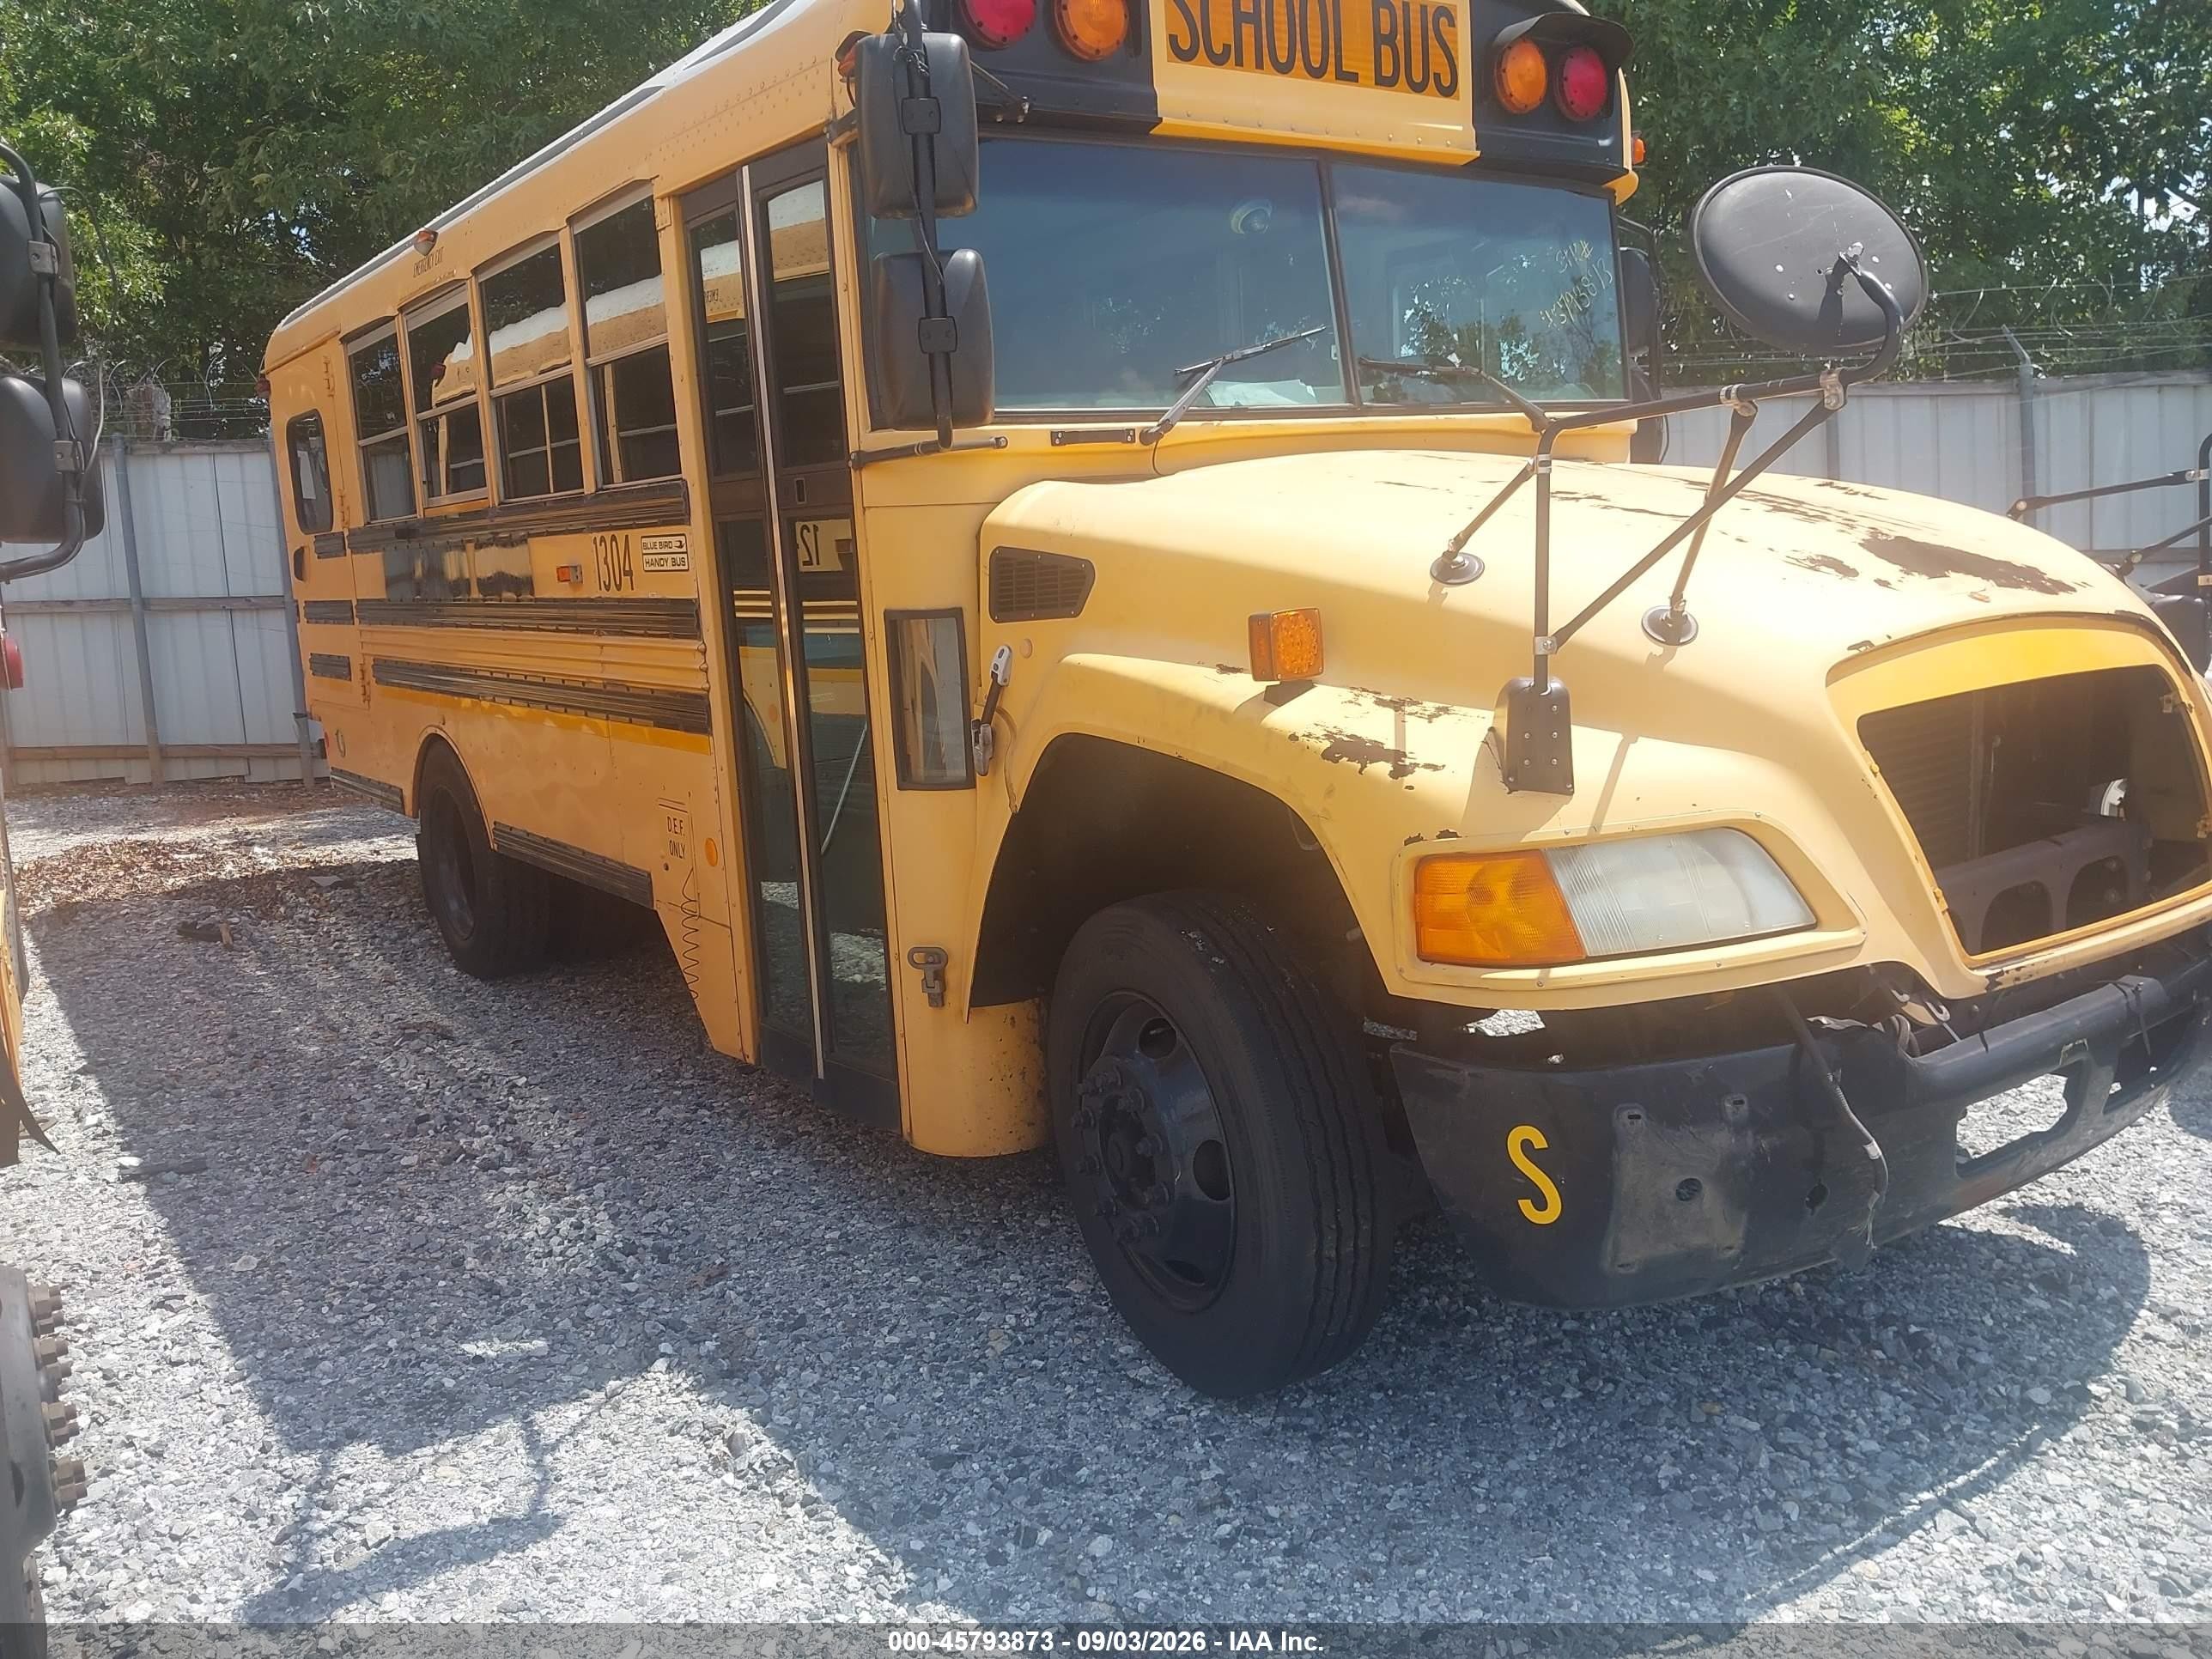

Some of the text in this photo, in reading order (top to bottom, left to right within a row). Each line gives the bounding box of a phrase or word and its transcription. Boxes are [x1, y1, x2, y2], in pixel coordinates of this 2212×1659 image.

[1169, 0, 1458, 98] SCHOOL BUS
[643, 540, 673, 550] BLUE BIRD
[592, 534, 635, 592] 1304
[645, 556, 686, 568] HANDY BUS
[666, 816, 685, 836] D.E.F.
[669, 839, 686, 860] ONLY
[1507, 1124, 1562, 1225] S
